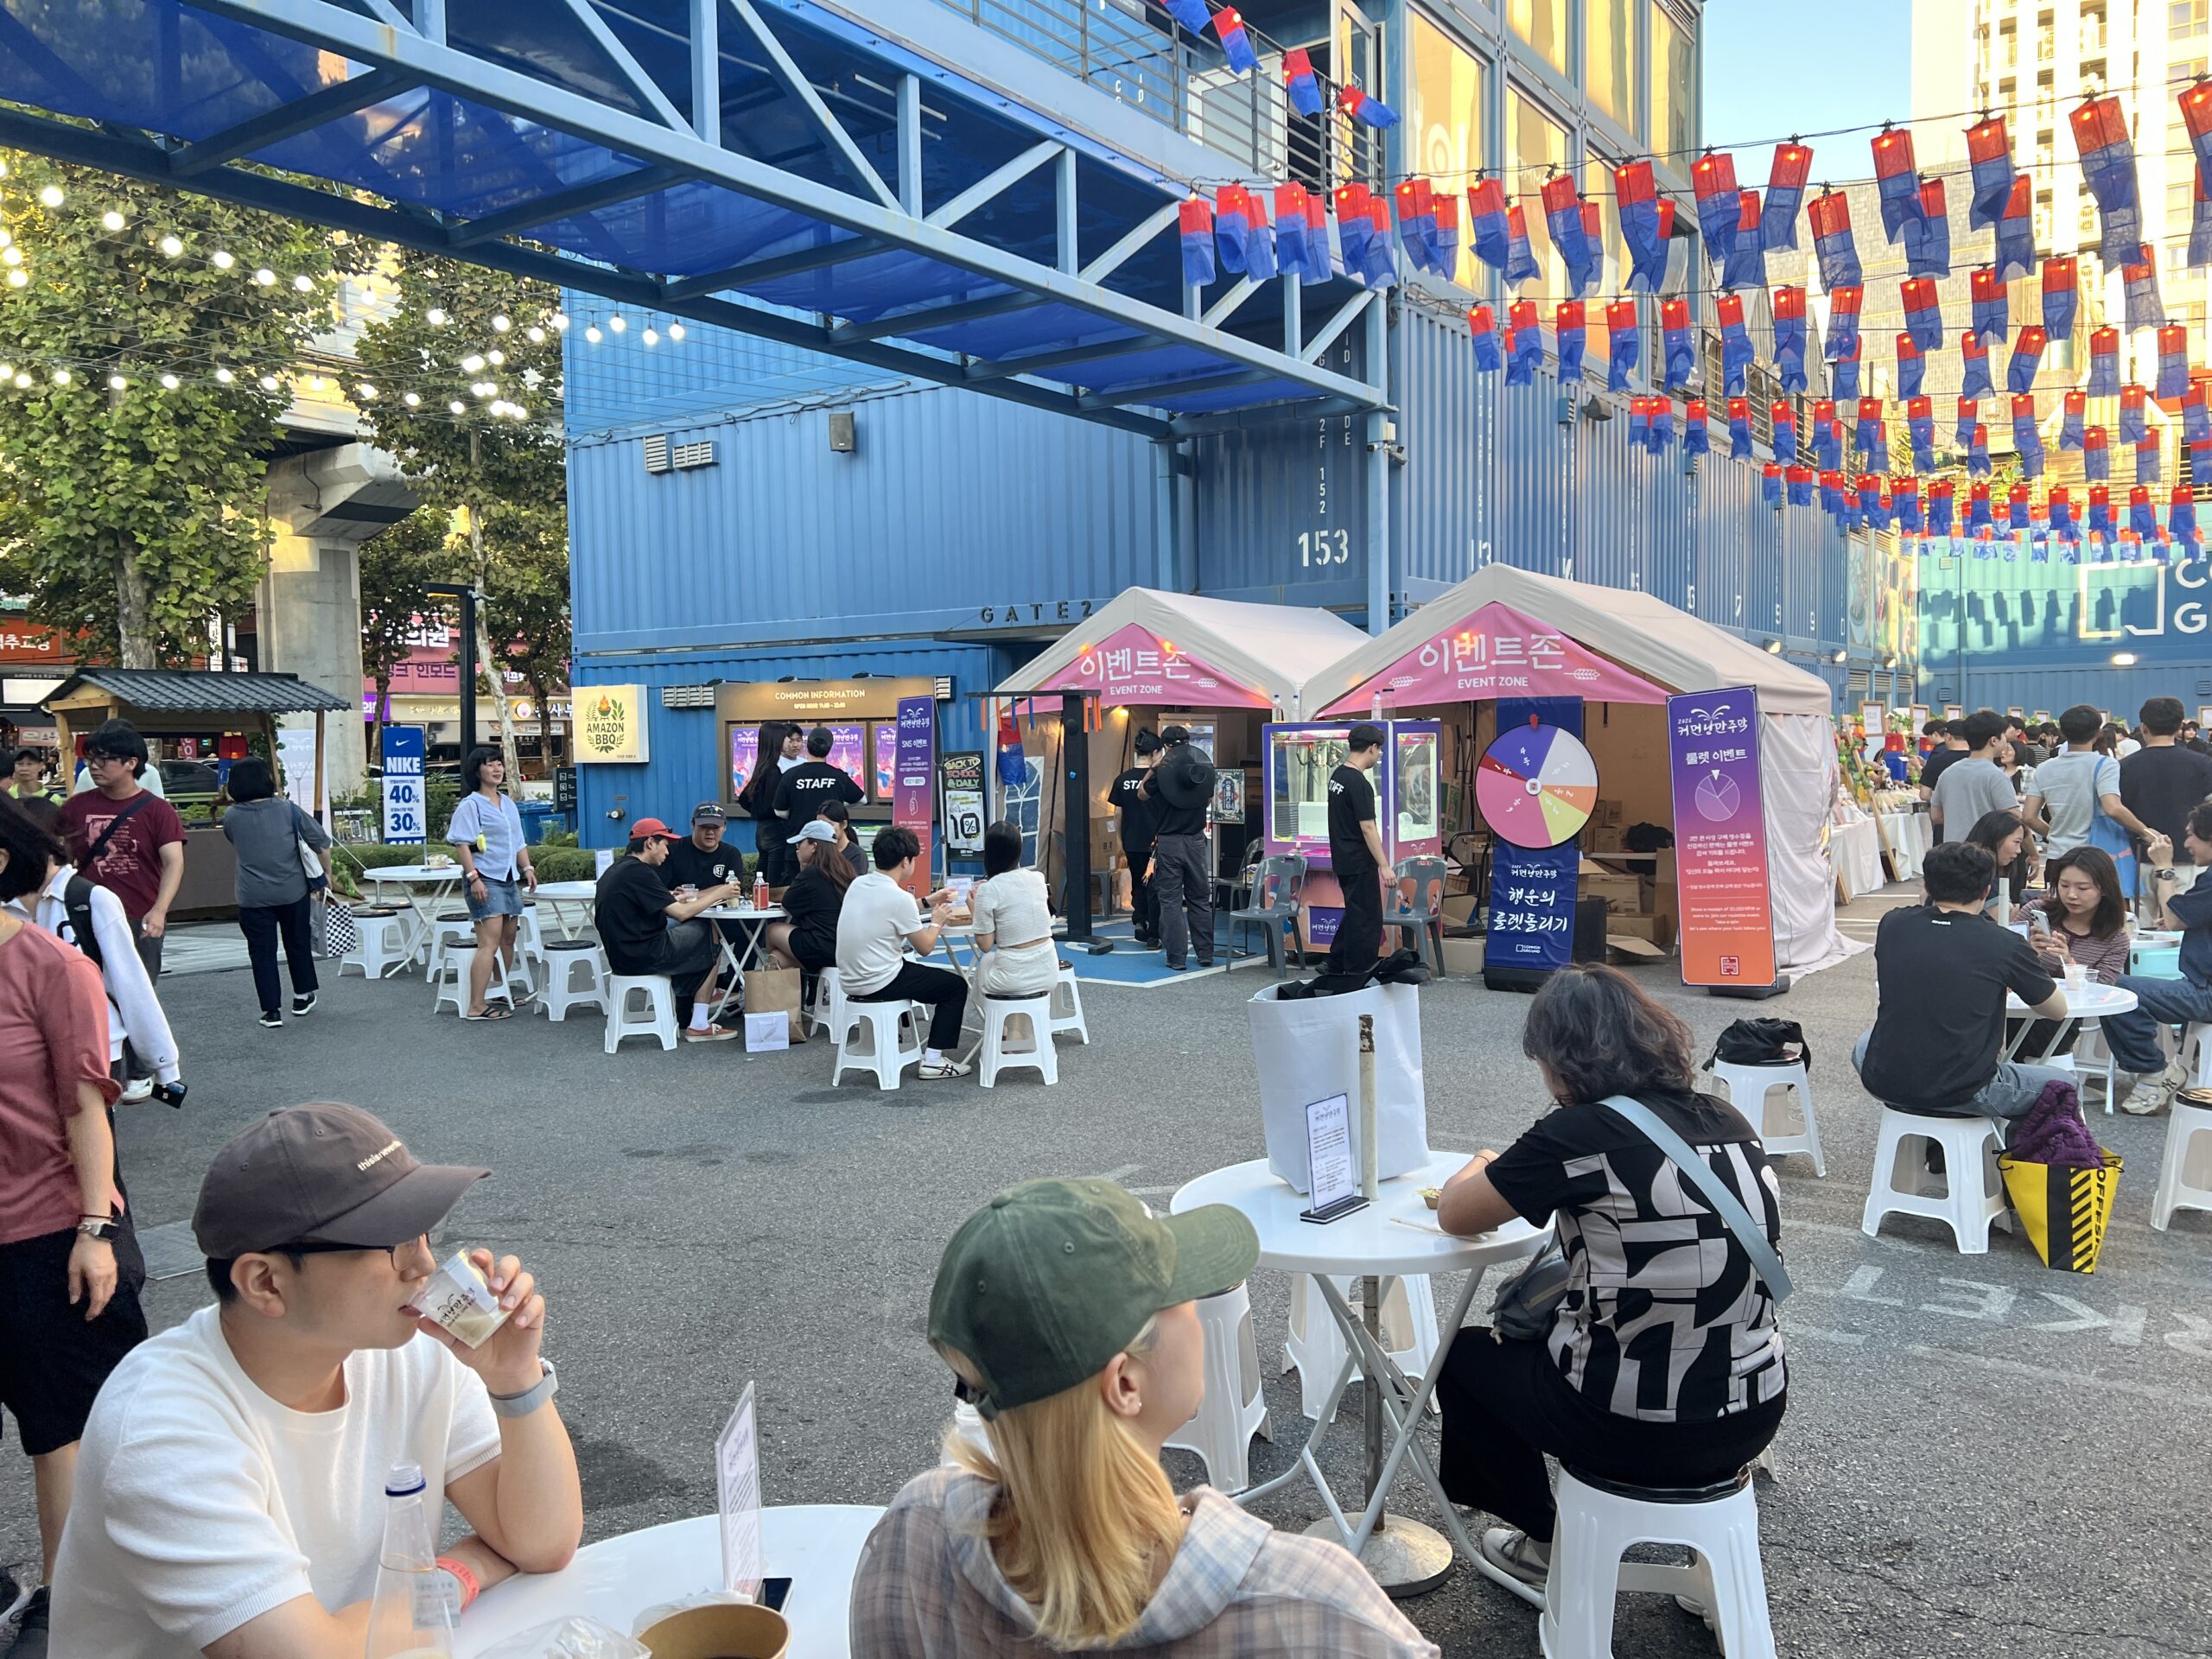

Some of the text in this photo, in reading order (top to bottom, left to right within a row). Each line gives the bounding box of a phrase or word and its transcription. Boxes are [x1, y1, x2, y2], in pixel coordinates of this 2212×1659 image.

[1298, 528, 1349, 568] 153
[1419, 633, 1565, 674] 이벤트존
[416, 663, 456, 678] 인모드
[1081, 647, 1191, 682] 이벤트존
[1110, 684, 1162, 696] EVENT ZONE
[1458, 677, 1529, 689] EVENT ZONE
[775, 690, 865, 700] COMMON INFORMATION
[587, 722, 625, 733] AMAZON
[1678, 717, 1748, 736] 커먼낭만주막
[595, 734, 616, 745] BBQ
[386, 757, 421, 773] NIKE
[1686, 749, 1748, 765] 룰렛 이벤트
[796, 778, 836, 790] STAFF
[1123, 780, 1142, 790] STA
[390, 785, 420, 804] 40%
[391, 813, 421, 832] 30%
[1511, 869, 1557, 879] 커먼낭만주막
[1509, 887, 1555, 906] 행운의
[1494, 912, 1567, 932] 룰렛돌리기
